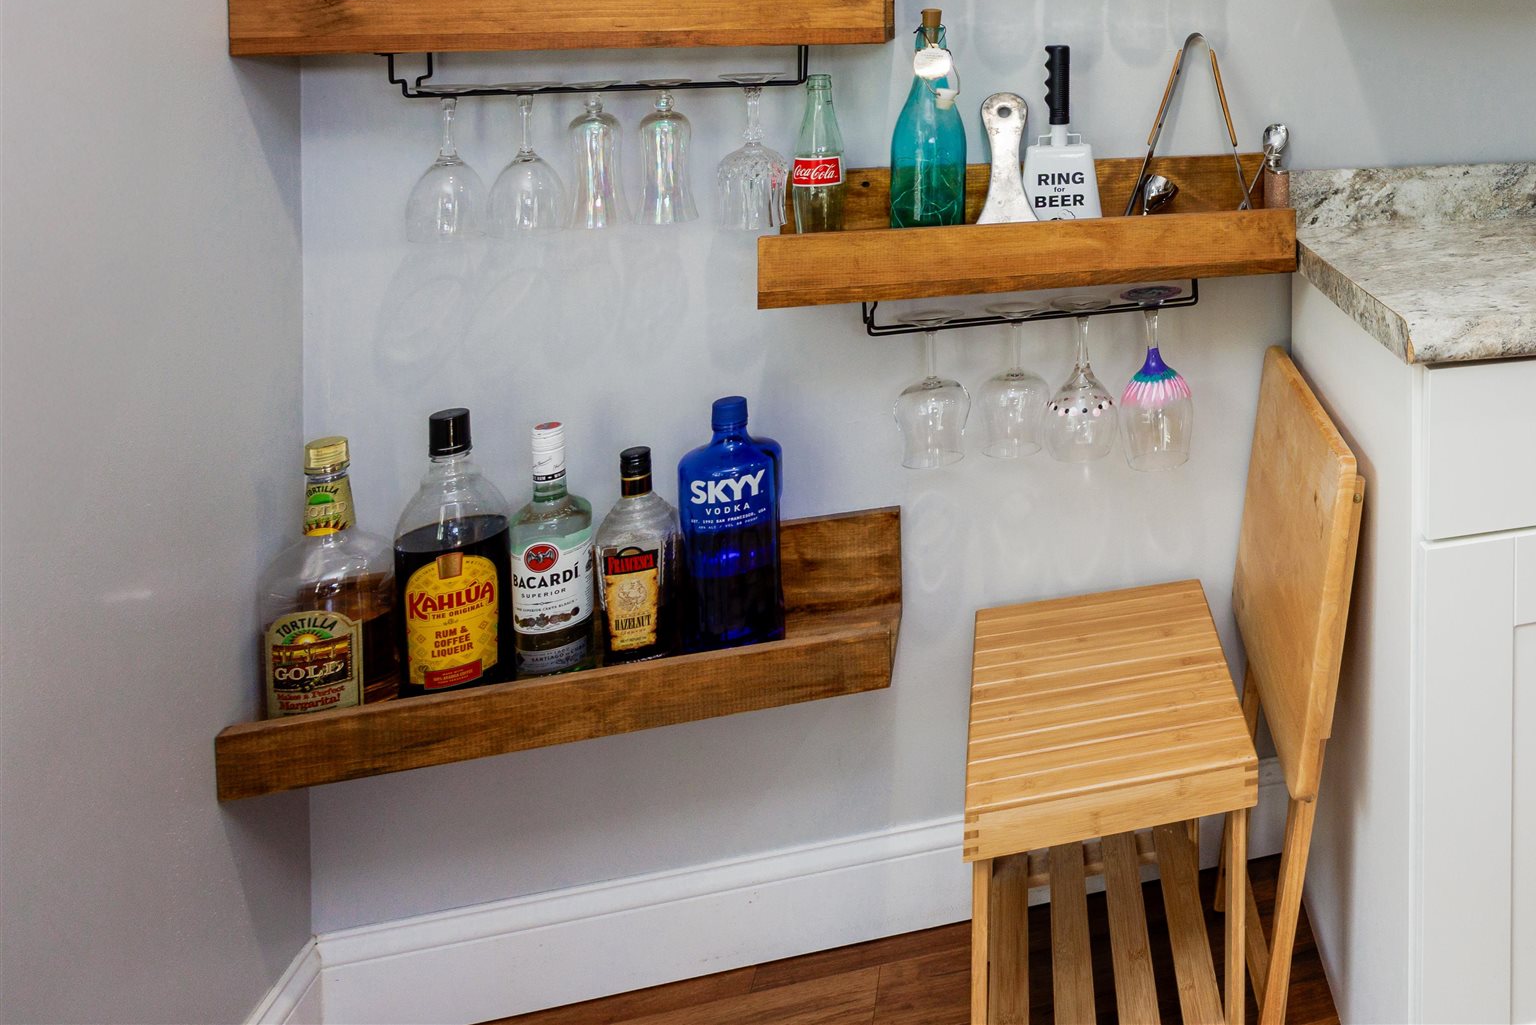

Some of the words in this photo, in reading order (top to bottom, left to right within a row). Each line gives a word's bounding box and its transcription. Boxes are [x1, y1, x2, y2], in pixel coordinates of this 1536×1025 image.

[793, 163, 838, 180] Coca-Cola
[1037, 171, 1085, 186] RING
[1034, 193, 1085, 209] BEER
[306, 485, 340, 497] TORTILLA
[690, 468, 766, 505] SKYY
[705, 502, 750, 516] VODKA
[513, 561, 580, 589] BACARDÍ
[408, 581, 495, 621] KAHLÚA
[521, 587, 567, 599] SUPERIOR
[432, 612, 446, 620] THE
[448, 602, 484, 617] ORIGINAL
[276, 617, 338, 638] TORTILLA
[614, 614, 652, 631] HAZELNUT
[434, 633, 471, 649] COFFEE
[435, 628, 457, 640] RUM
[460, 625, 469, 634] &
[431, 641, 474, 659] LIQUEUR
[274, 660, 345, 681] GOLD
